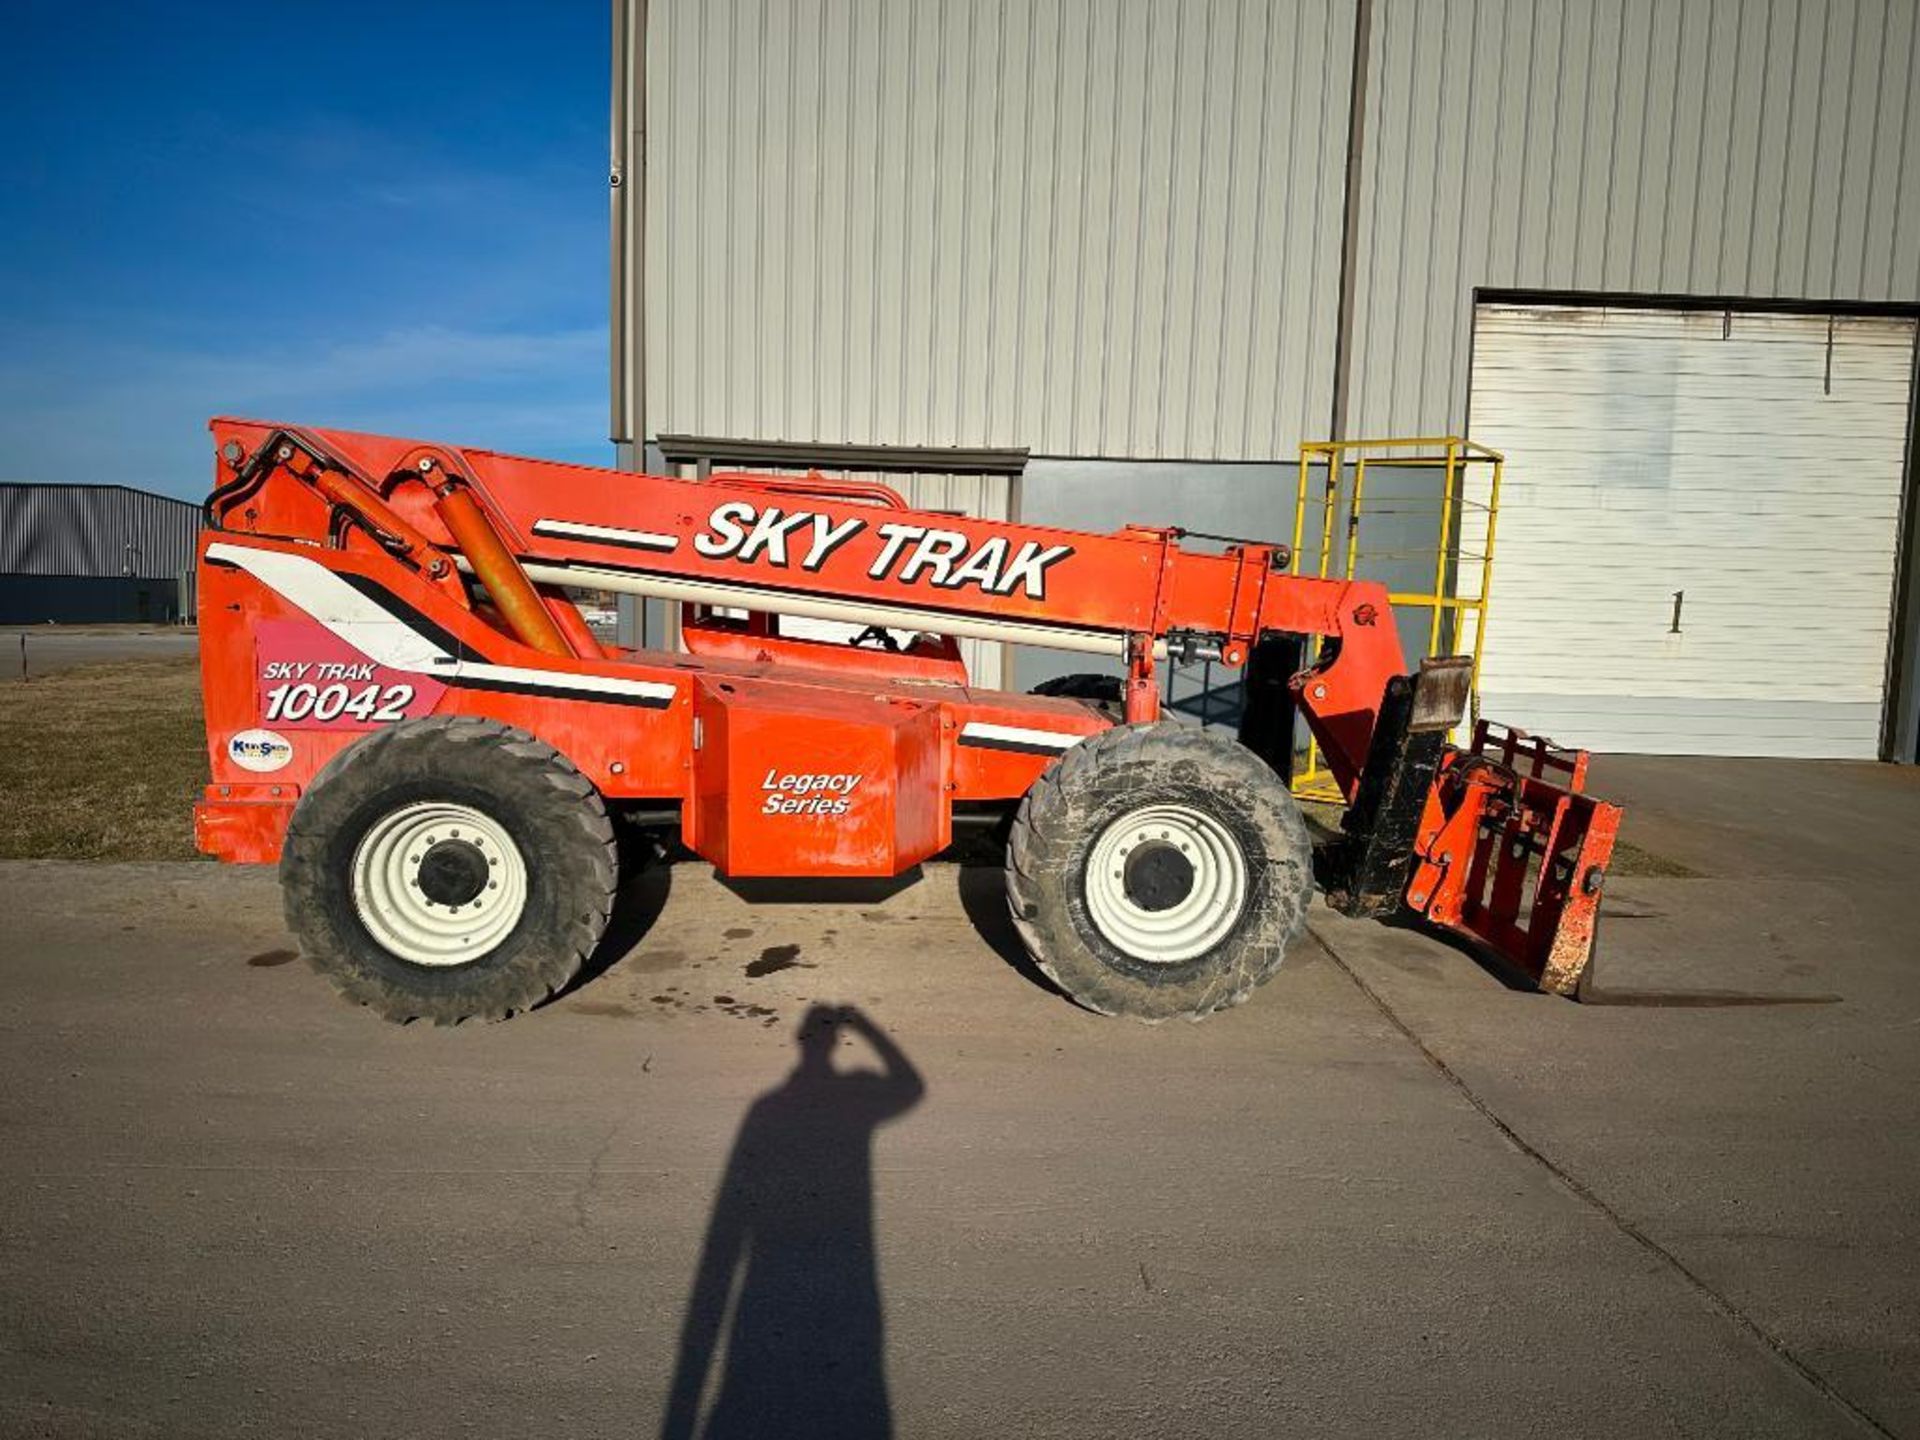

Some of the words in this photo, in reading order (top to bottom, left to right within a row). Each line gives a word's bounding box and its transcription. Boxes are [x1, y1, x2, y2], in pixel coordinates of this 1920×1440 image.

[693, 501, 867, 573] SKY
[868, 522, 1075, 601] TRAK
[1667, 591, 1684, 633] 1
[264, 661, 313, 680] SKY
[315, 662, 380, 682] TRAK
[265, 683, 416, 722] 10042
[761, 769, 863, 796] Legacy
[761, 793, 850, 815] Series
